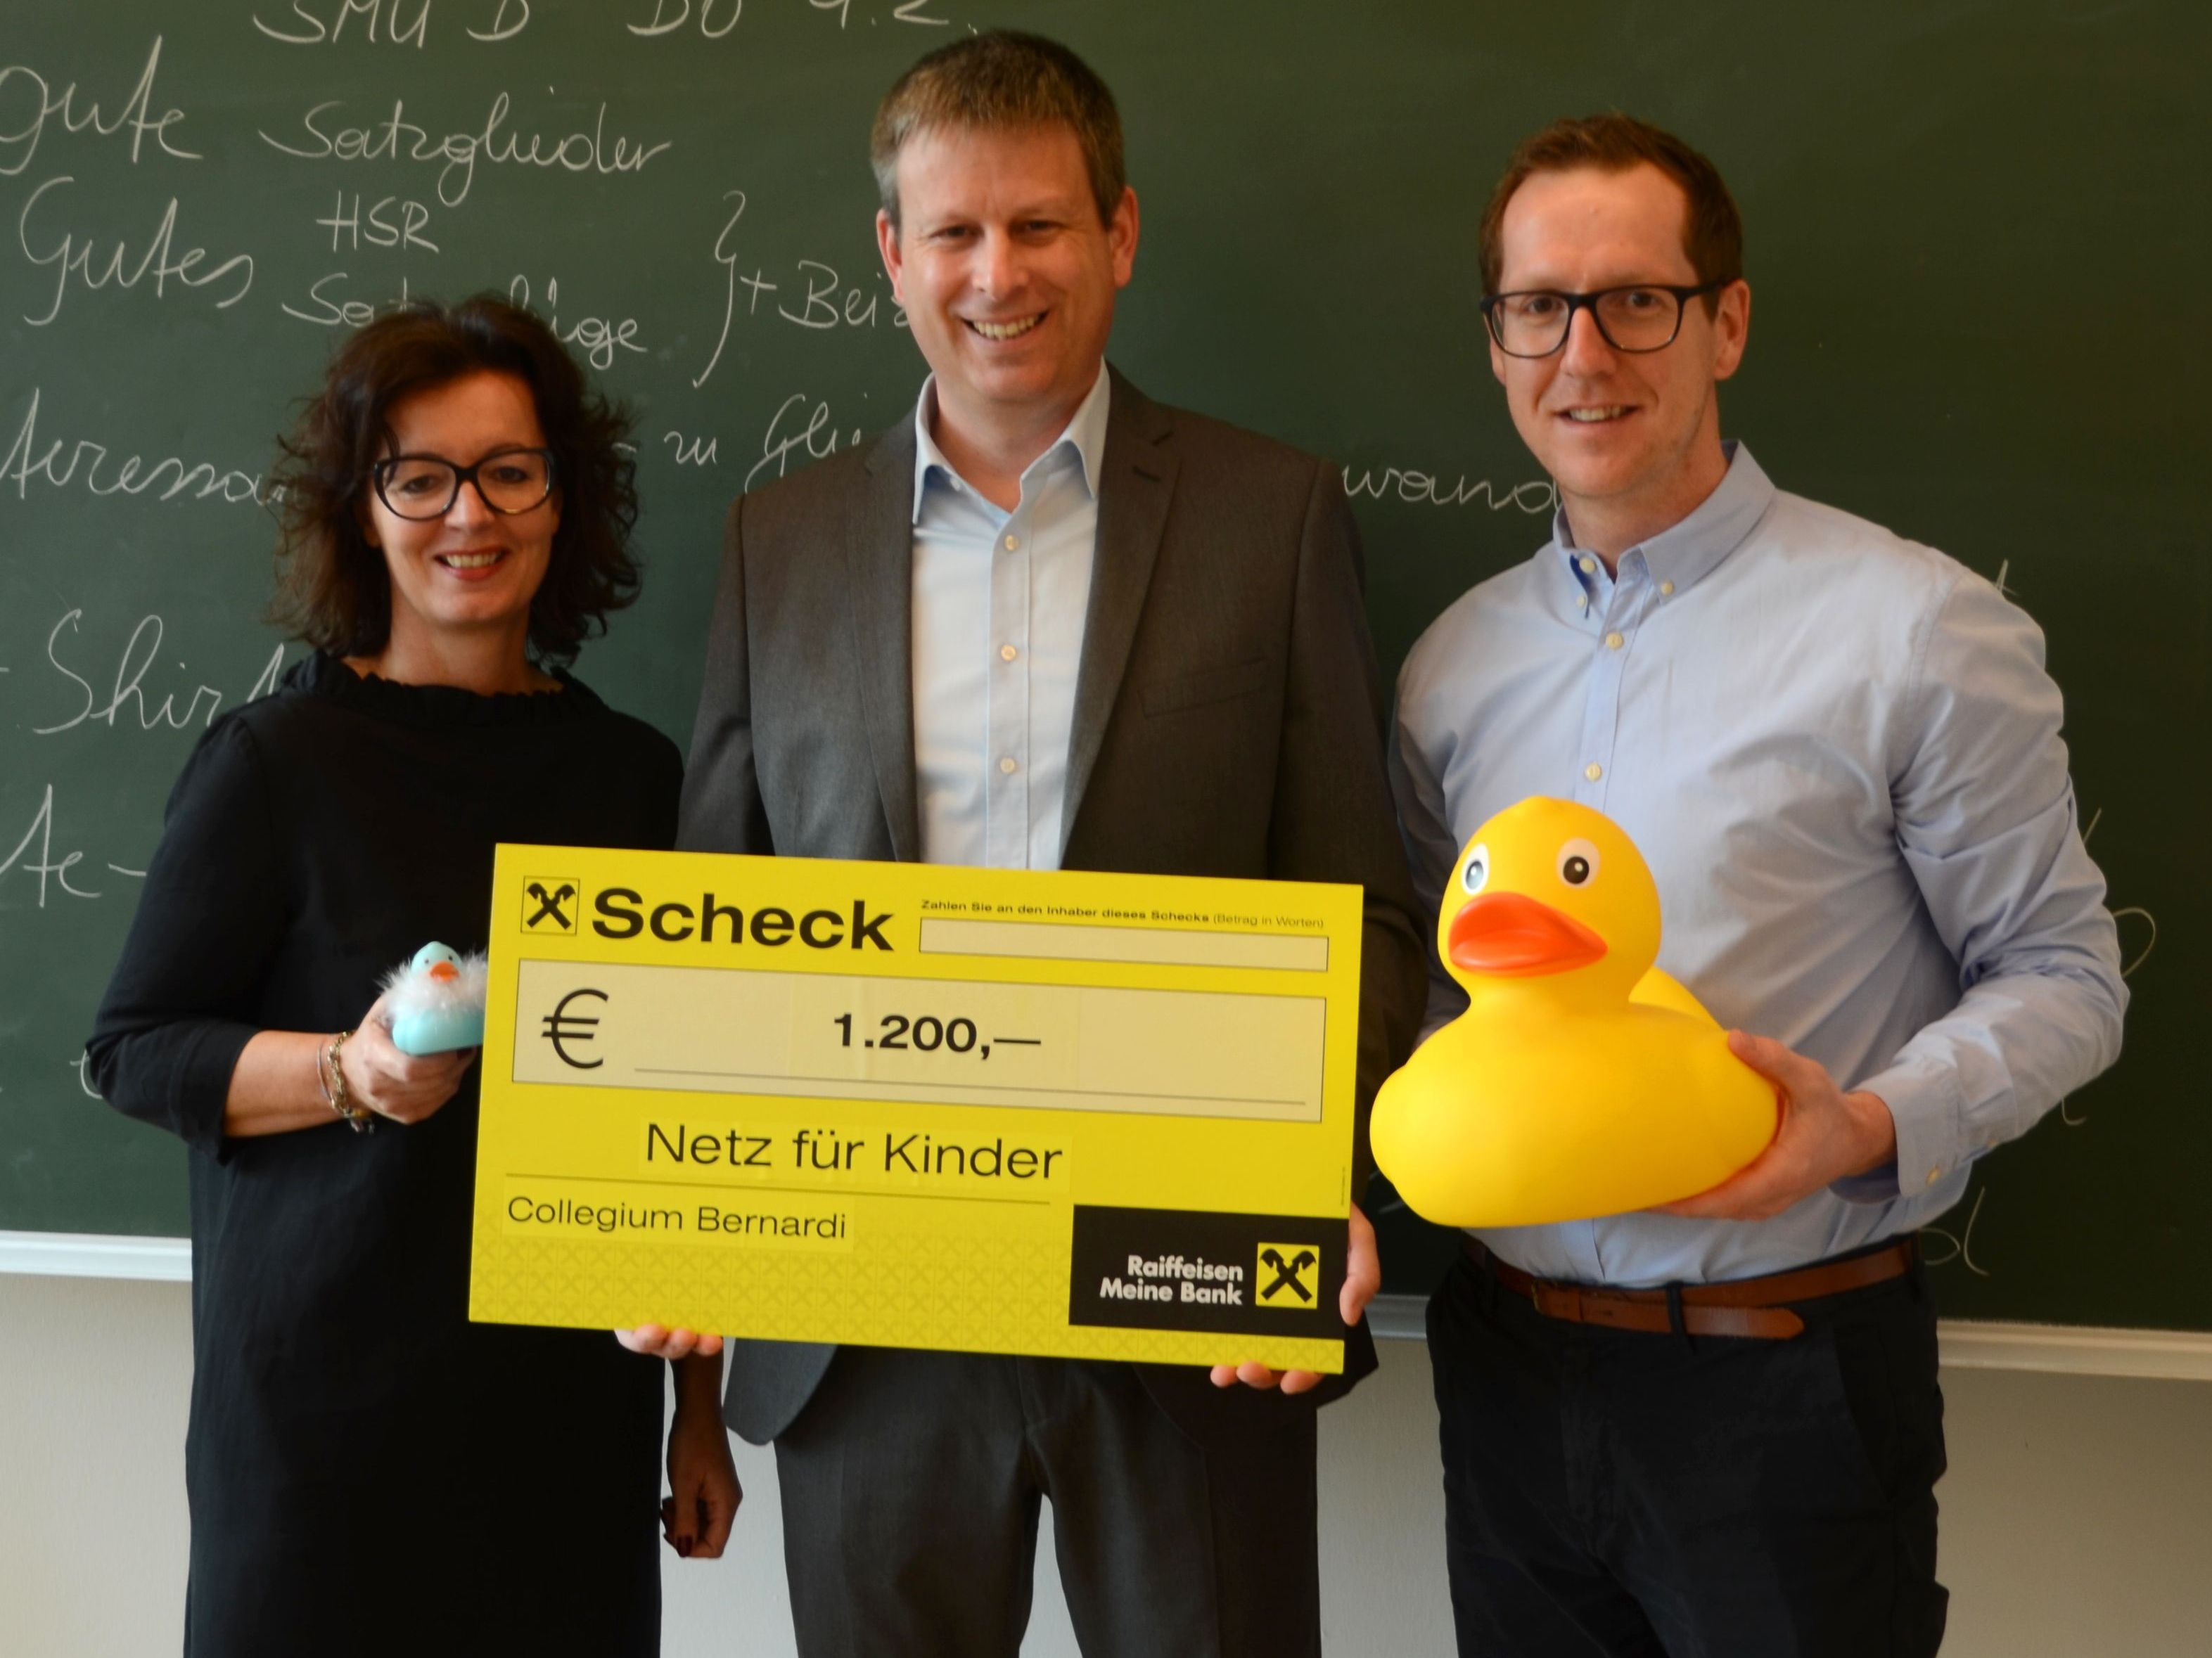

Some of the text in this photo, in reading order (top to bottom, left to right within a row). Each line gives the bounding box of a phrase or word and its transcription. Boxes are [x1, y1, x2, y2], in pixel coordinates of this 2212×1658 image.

[317, 191, 439, 253] HSR
[20, 176, 253, 326] Gutes
[592, 887, 893, 951] Scheck
[921, 899, 1324, 929] Zahlen Sie an den Inhaber dieses Schecks (Betrag in Worten)
[541, 989, 609, 1069] €
[646, 1123, 1063, 1179] Netz für Kinder
[508, 1196, 846, 1238] Collegium Bernardi
[1099, 1277, 1243, 1306] Meine Bank
[1127, 1254, 1244, 1282] Raiffeisen
